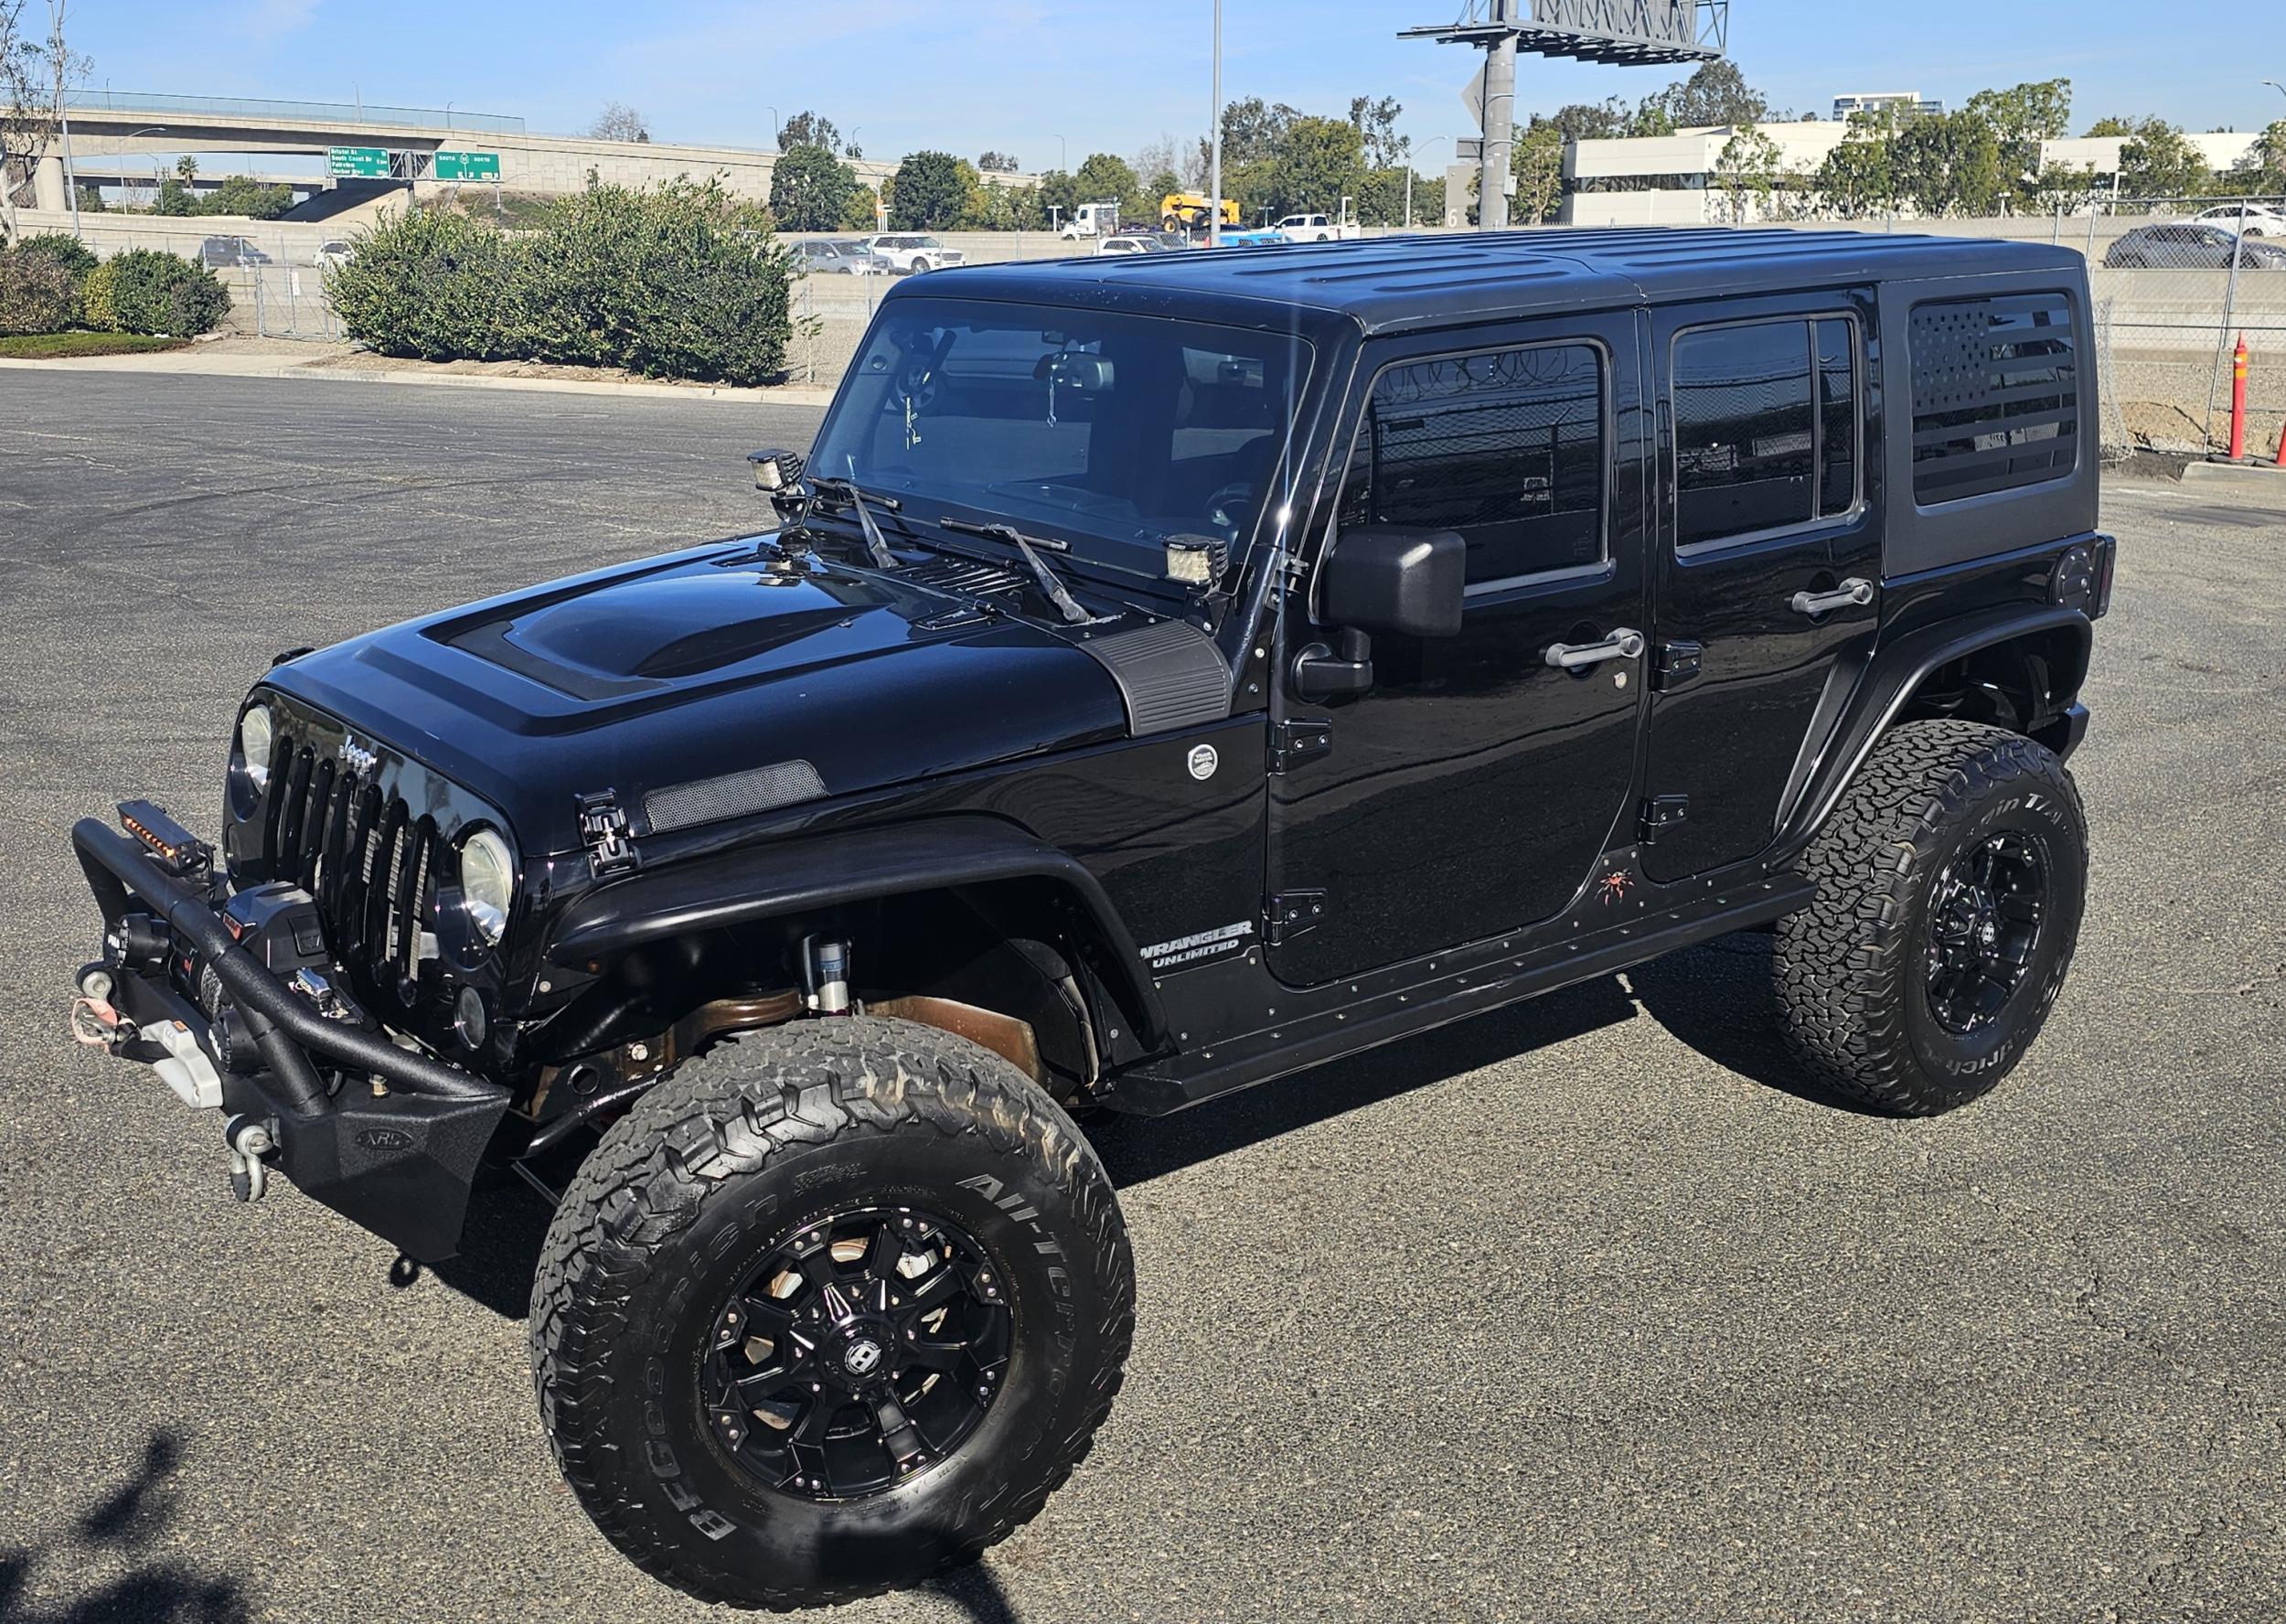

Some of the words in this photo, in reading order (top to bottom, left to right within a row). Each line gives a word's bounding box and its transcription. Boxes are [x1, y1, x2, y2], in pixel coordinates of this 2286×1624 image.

[1447, 208, 1458, 228] 6
[338, 734, 378, 777] Jeep
[1139, 920, 1255, 959] WRANGLER
[1152, 939, 1239, 968] UNLIMITED
